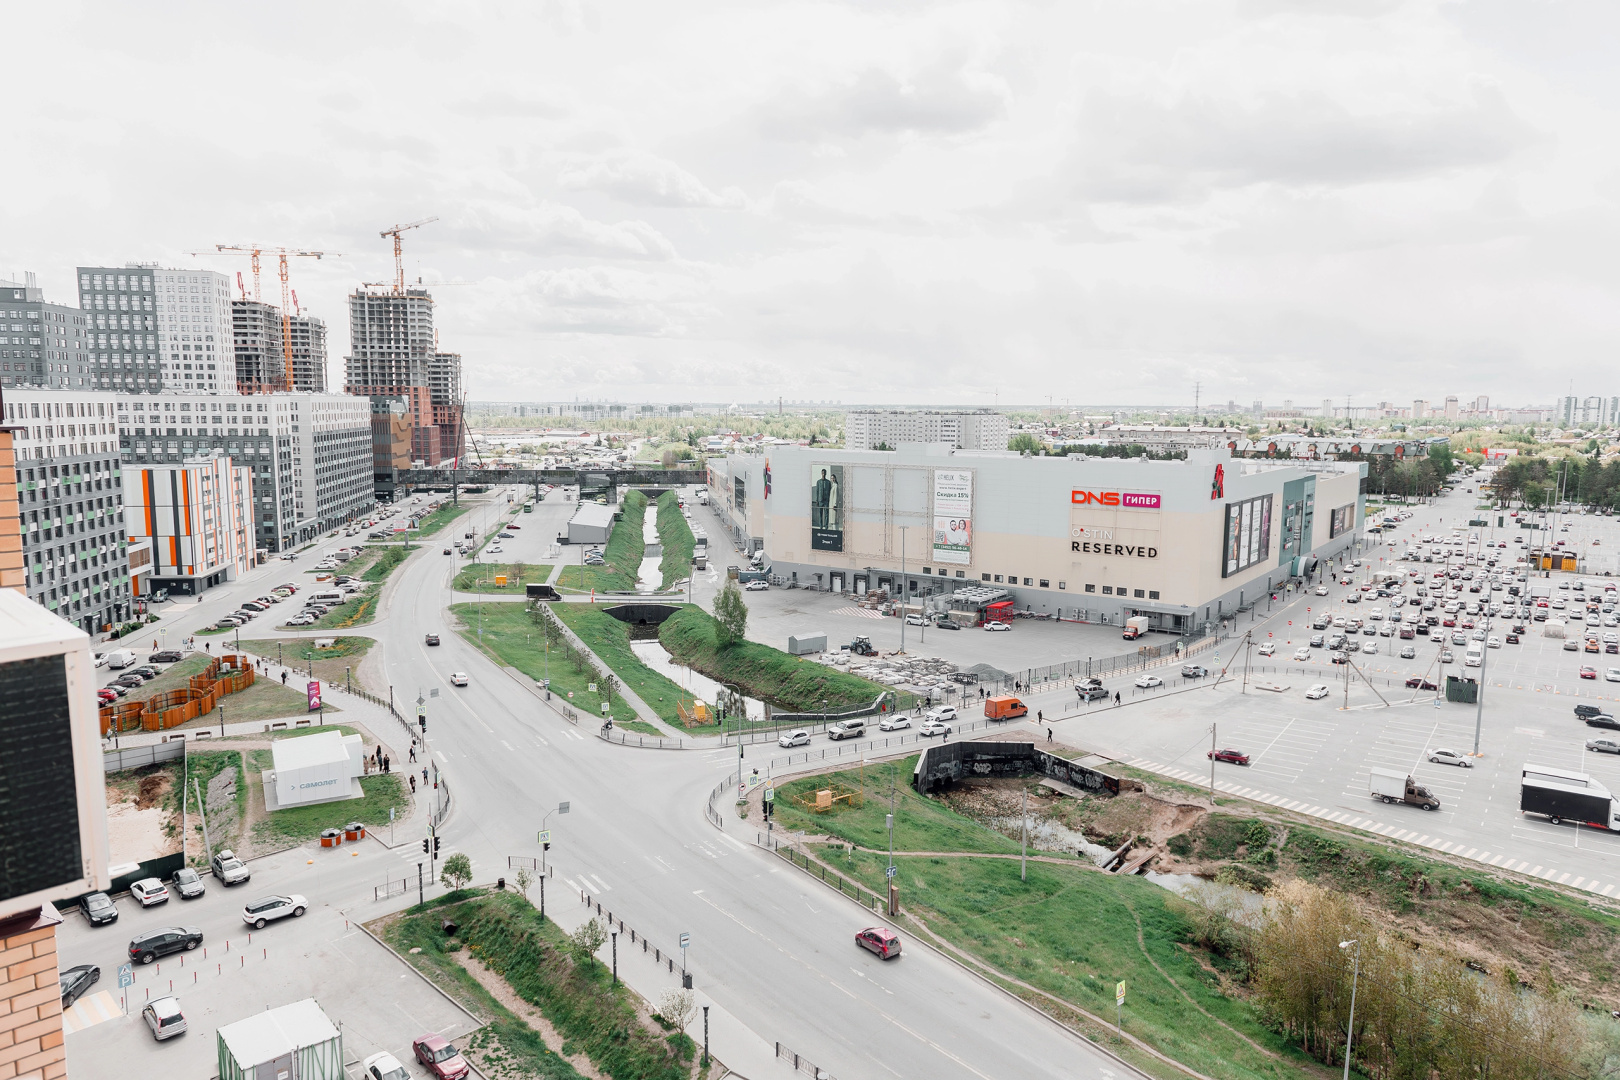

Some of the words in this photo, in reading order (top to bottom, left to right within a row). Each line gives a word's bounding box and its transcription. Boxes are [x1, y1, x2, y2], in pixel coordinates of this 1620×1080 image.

[1071, 490, 1120, 506] DNS
[1126, 496, 1158, 505] ГИПЕР
[1071, 541, 1158, 558] RESERVED
[122, 976, 130, 987] P
